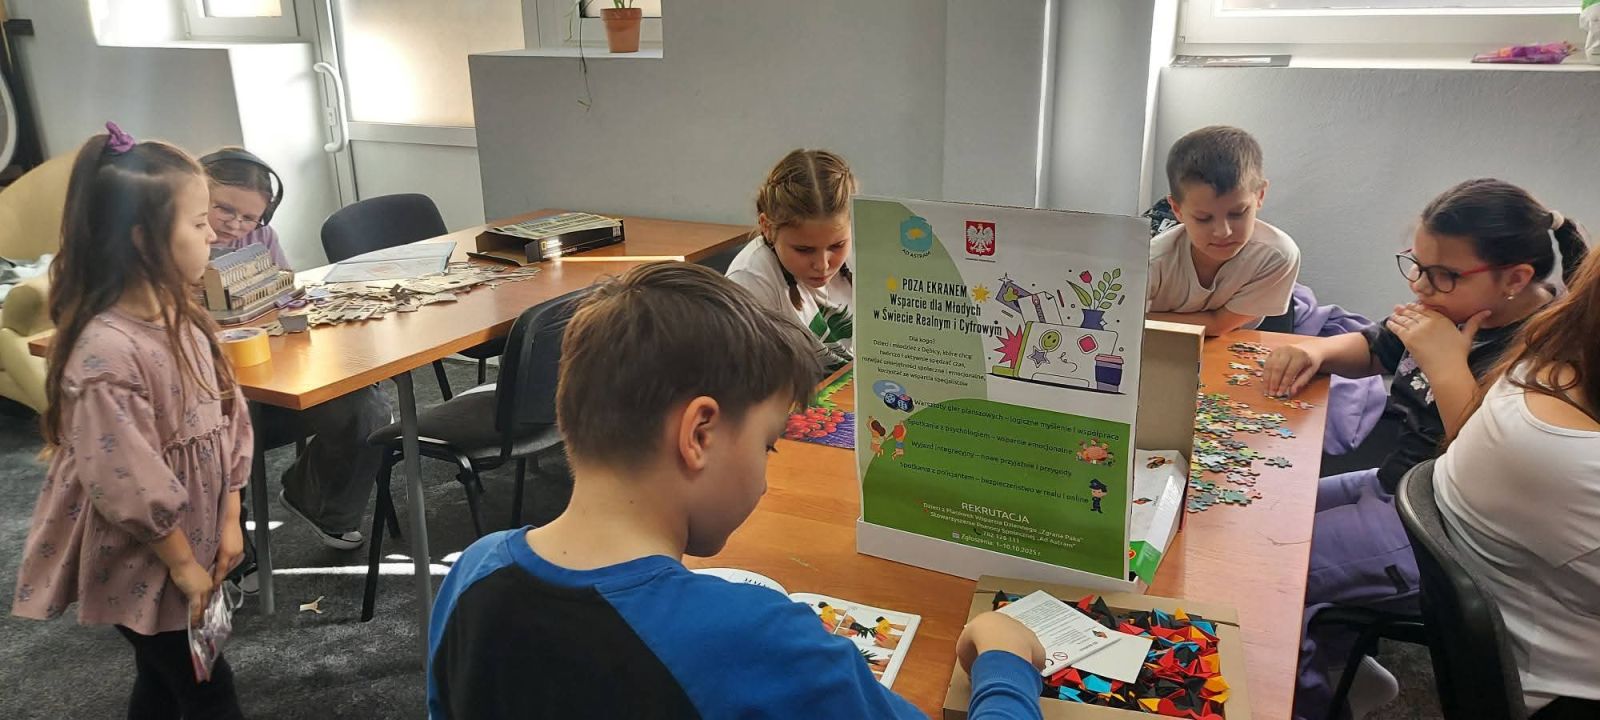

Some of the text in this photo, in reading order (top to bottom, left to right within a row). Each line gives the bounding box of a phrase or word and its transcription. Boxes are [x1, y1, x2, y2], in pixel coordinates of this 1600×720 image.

[902, 278, 968, 298] POZA EKRANEM
[890, 293, 981, 318] Wsparcie dla Młodych
[874, 307, 1002, 337] w Świecie Realnym i Cyfrowym
[920, 337, 936, 345] kogo?
[922, 346, 941, 356] Dębicy,
[942, 349, 957, 358] które
[958, 352, 972, 360] chcą
[880, 350, 900, 358] twórczo
[904, 353, 928, 362] aktywnie
[929, 356, 952, 366] spędzać
[952, 361, 966, 369] czas,
[878, 366, 902, 376] korzystać
[910, 372, 934, 382] wsparcia
[934, 376, 968, 386] specjalistów
[918, 365, 945, 374] społeczne
[948, 370, 986, 381] emocjonalne,
[914, 400, 946, 411] Warsztaty
[947, 405, 960, 413] gier
[961, 408, 1004, 420] planszowych
[1010, 415, 1038, 426] logiczne
[1040, 422, 1072, 432] myślenie
[1078, 428, 1119, 440] współpraca
[945, 426, 991, 438] psychologiem
[996, 435, 1027, 446] wsparcie
[1028, 440, 1073, 454] emocjonalne
[911, 441, 934, 450] Wyjazd
[935, 444, 975, 459] integracyjny
[981, 454, 998, 462] nowe
[1000, 458, 1034, 469] przyjaźnie
[1040, 464, 1072, 477] przygody
[937, 469, 974, 481] policjantem
[981, 477, 1034, 494] bezpieczeństwo
[1044, 490, 1061, 498] realu
[1066, 494, 1089, 504] online
[923, 502, 941, 511] Dzieci
[974, 515, 1002, 526] Wsparcia
[1003, 521, 1037, 533] Dziennego
[961, 502, 1030, 524] REKRUTACJA
[930, 512, 976, 526] Stowarzyszenie
[977, 520, 1001, 532] Pomocy
[1001, 527, 1035, 541] Społecznej
